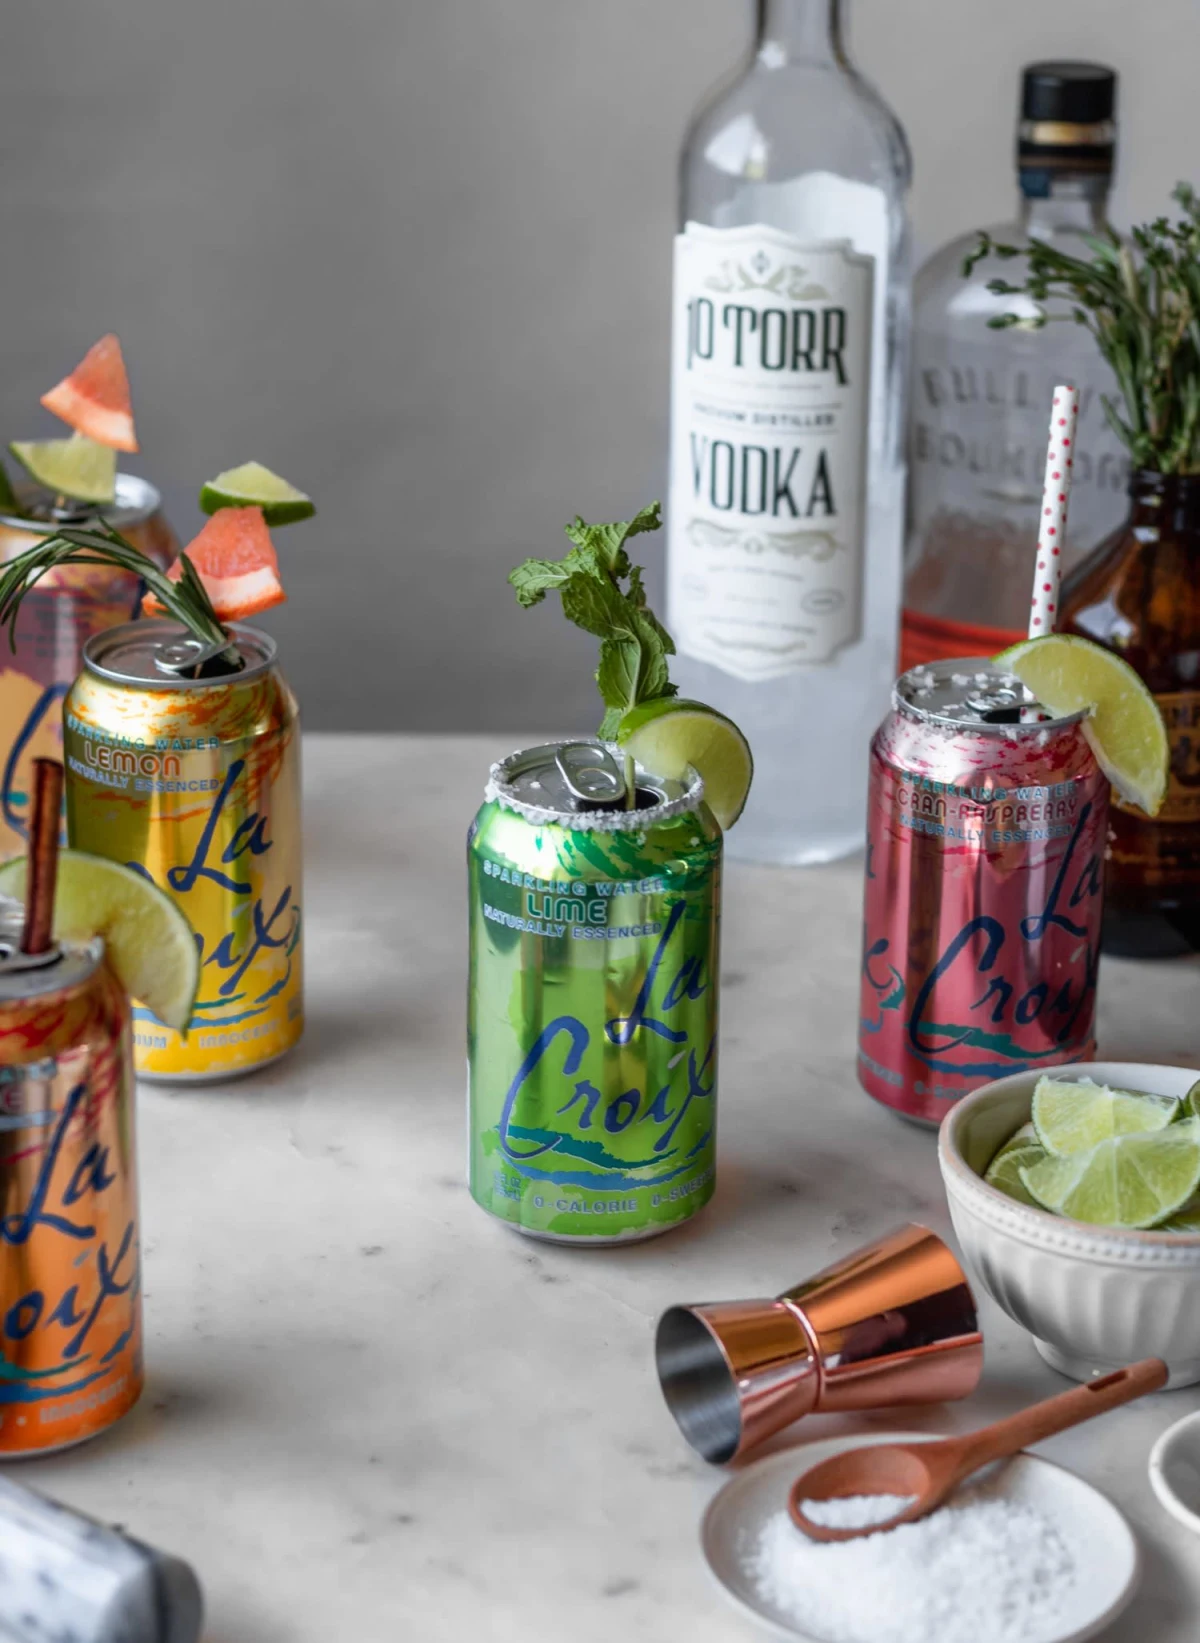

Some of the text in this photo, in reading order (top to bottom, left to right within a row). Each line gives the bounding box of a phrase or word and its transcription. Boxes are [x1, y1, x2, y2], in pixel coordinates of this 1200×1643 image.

[722, 303, 848, 386] TORR
[690, 432, 838, 518] VODKA
[84, 740, 182, 778] LEMON
[155, 736, 220, 752] WATER
[134, 778, 220, 793] ESSENCED
[901, 770, 1077, 801] SPARKLING WATER
[895, 786, 1078, 825] CRAN-RASPBERRY
[167, 759, 273, 894] La
[900, 814, 985, 841] NATURALLY
[483, 859, 665, 898] SPARKLING WATER
[1020, 801, 1100, 940] La
[483, 902, 663, 941] NATURALLY ESSENCED
[526, 892, 608, 924] LIME
[603, 899, 707, 1045] La
[132, 1034, 167, 1049] IUM
[499, 1014, 717, 1159] Croix
[0, 1082, 118, 1245] La
[532, 1196, 639, 1216] 0-CALORIE
